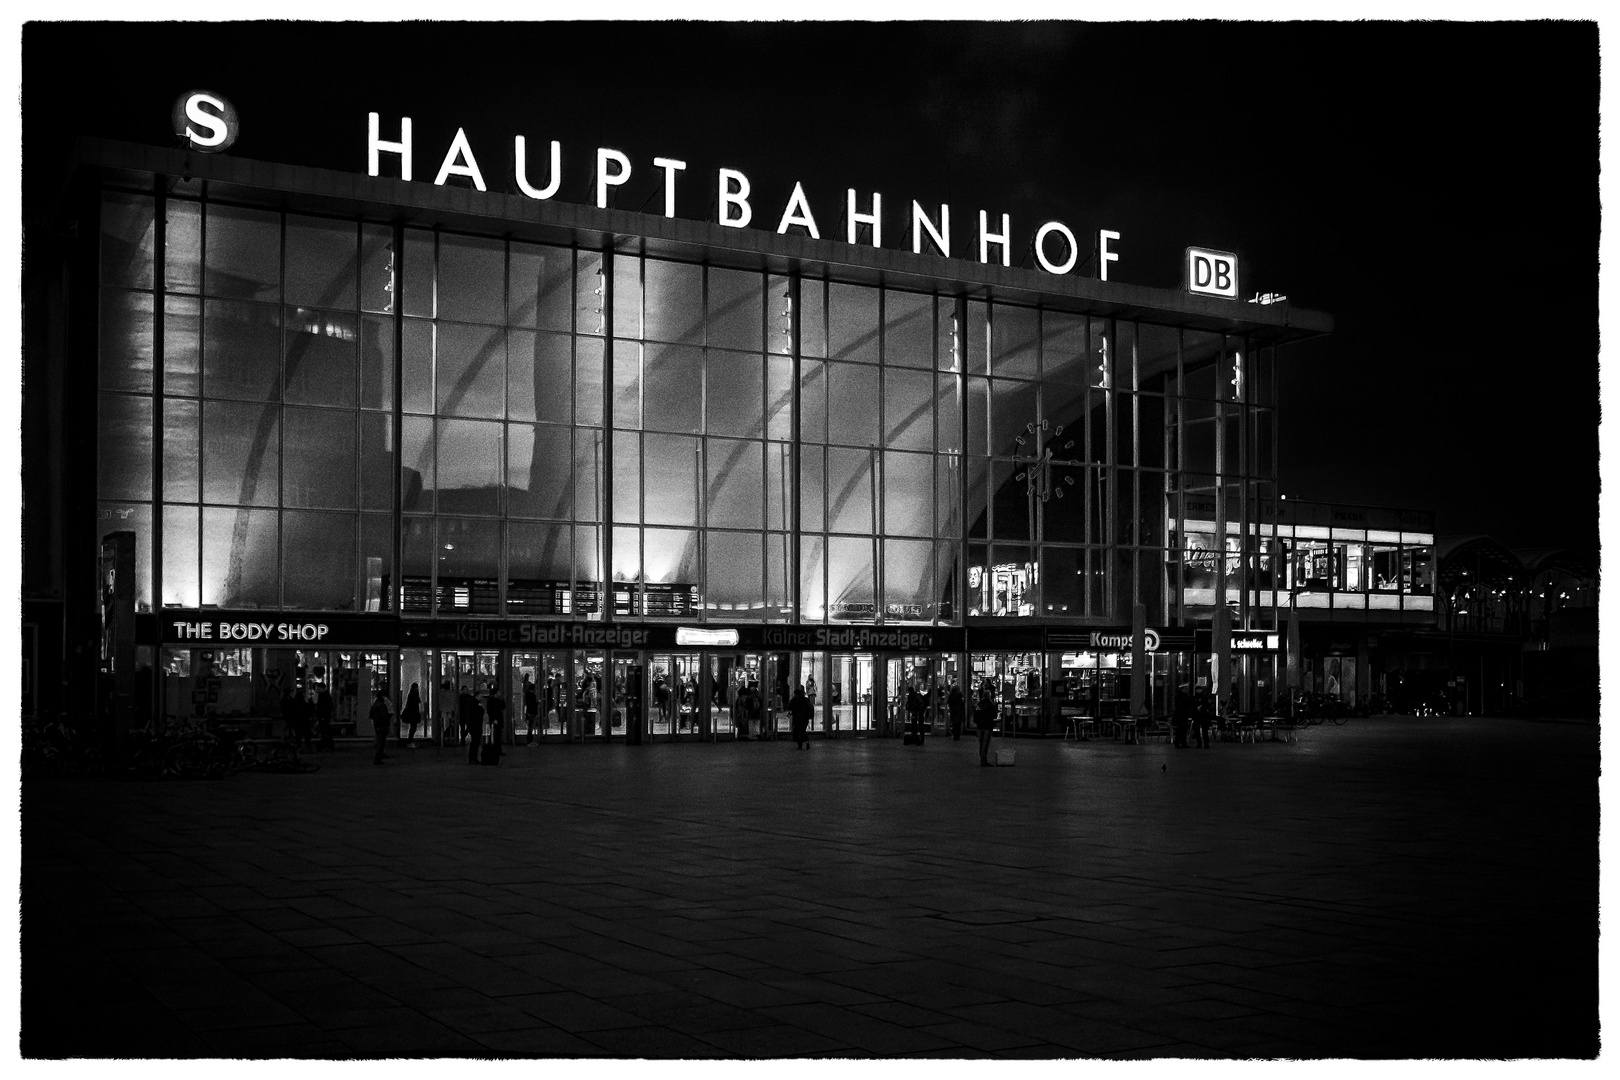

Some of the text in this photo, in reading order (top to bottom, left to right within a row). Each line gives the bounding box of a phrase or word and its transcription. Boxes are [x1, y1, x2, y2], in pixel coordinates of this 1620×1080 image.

[185, 93, 227, 147] S
[368, 111, 1121, 282] HAUPTBAHNHOF
[1193, 255, 1231, 290] DB
[173, 621, 328, 640] THE BODY SHOP
[456, 624, 649, 648] Kölner Stadt-Anzeiger
[761, 628, 924, 649] Kölner Stadt-Anzeiger
[1090, 630, 1132, 650] Kamps
